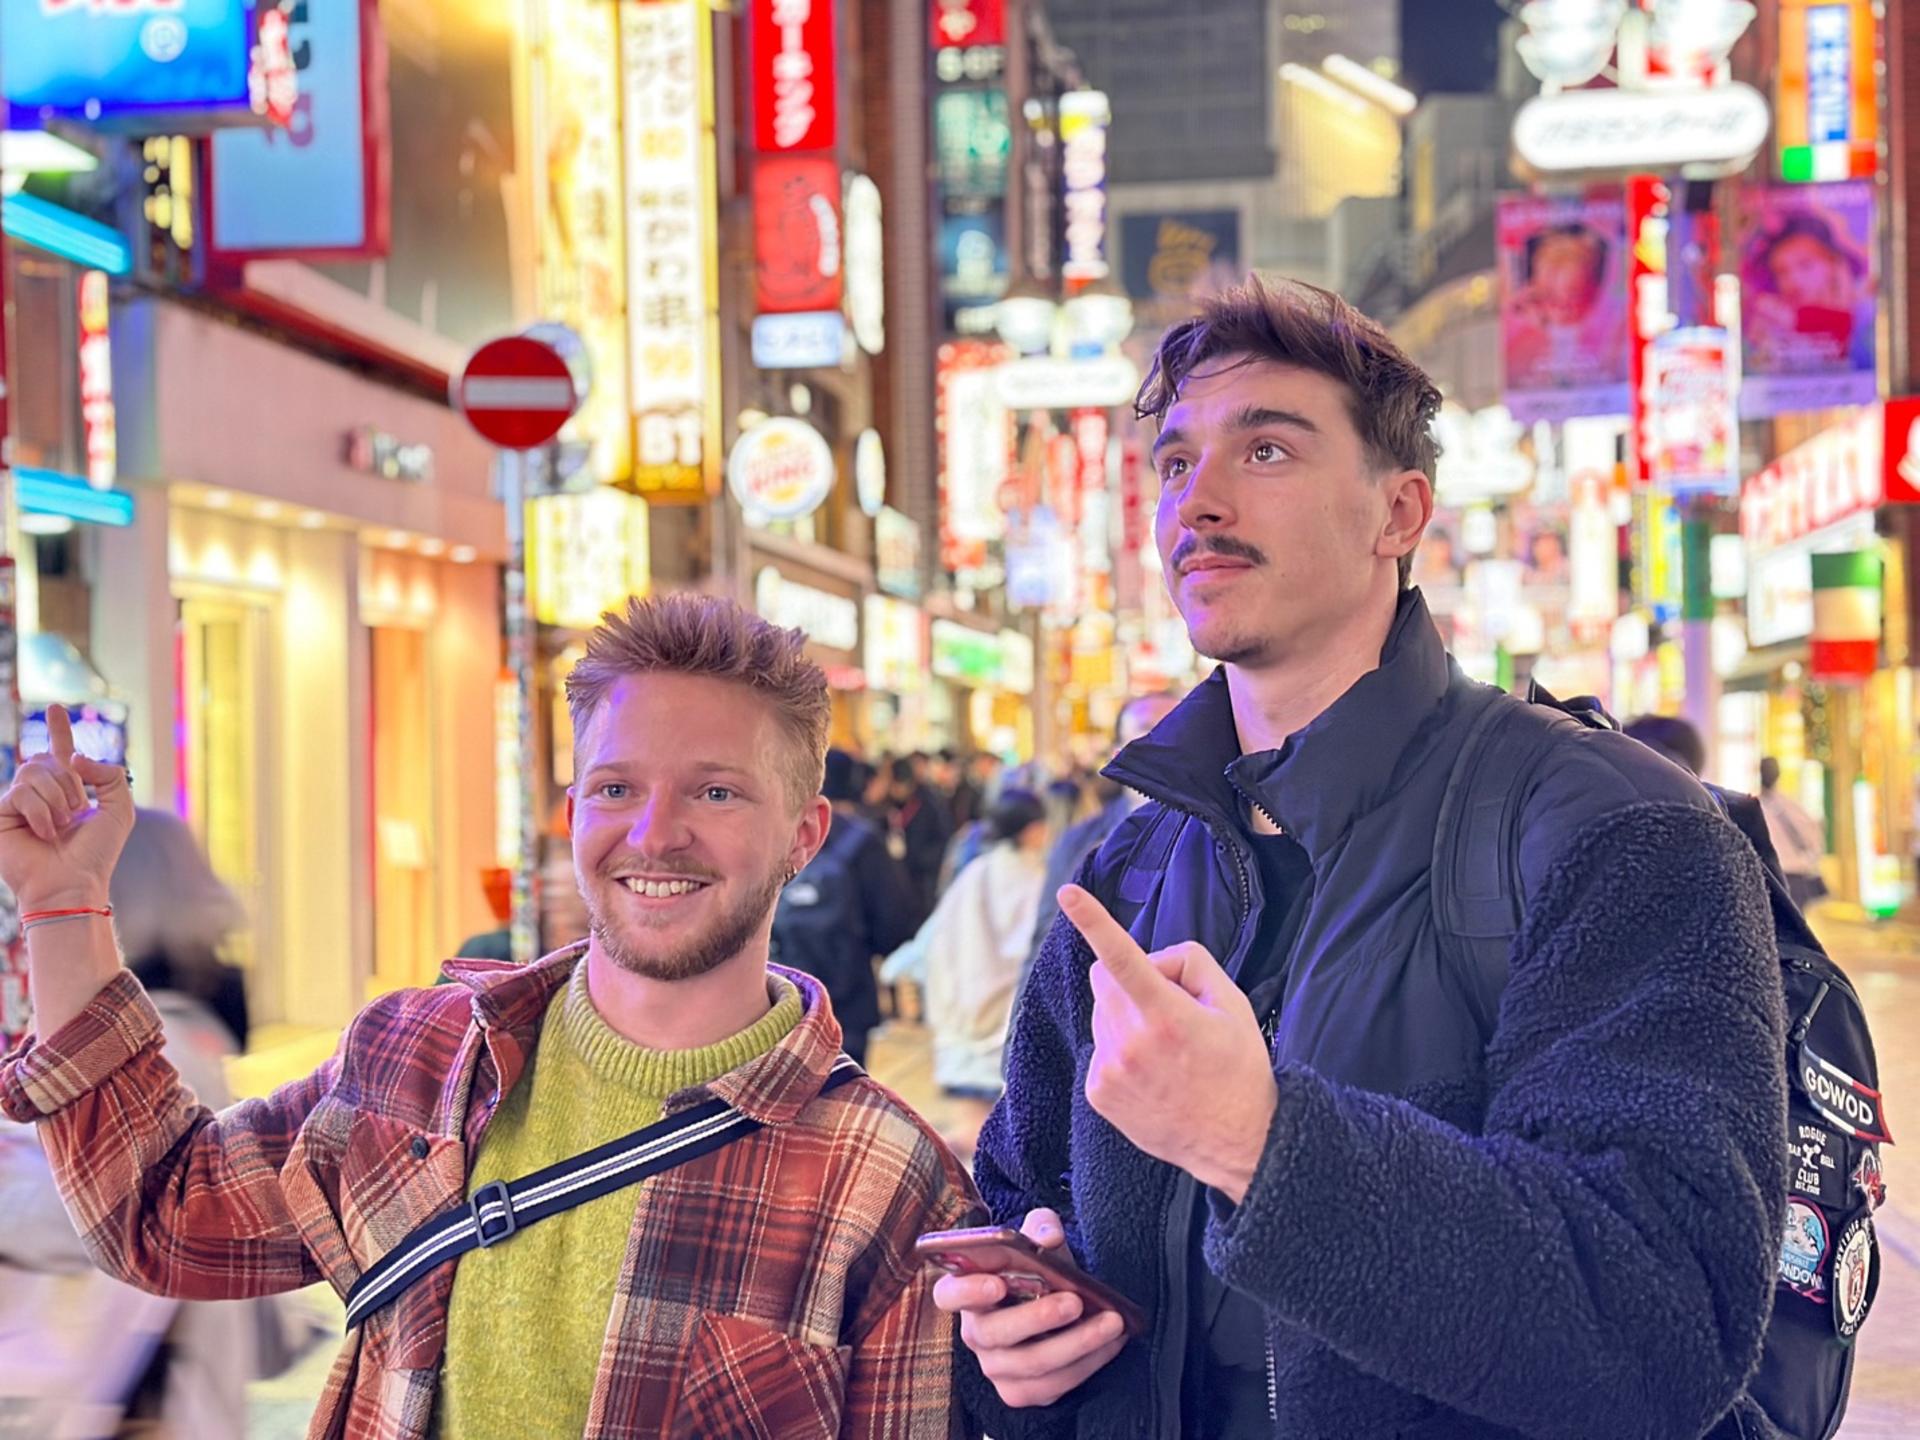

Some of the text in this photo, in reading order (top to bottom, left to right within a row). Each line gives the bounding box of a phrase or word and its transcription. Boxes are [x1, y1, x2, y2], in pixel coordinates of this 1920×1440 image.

[1804, 1066, 1873, 1125] GOWOD
[1798, 1125, 1827, 1147] ROGUE
[1797, 1167, 1819, 1186] CLUB
